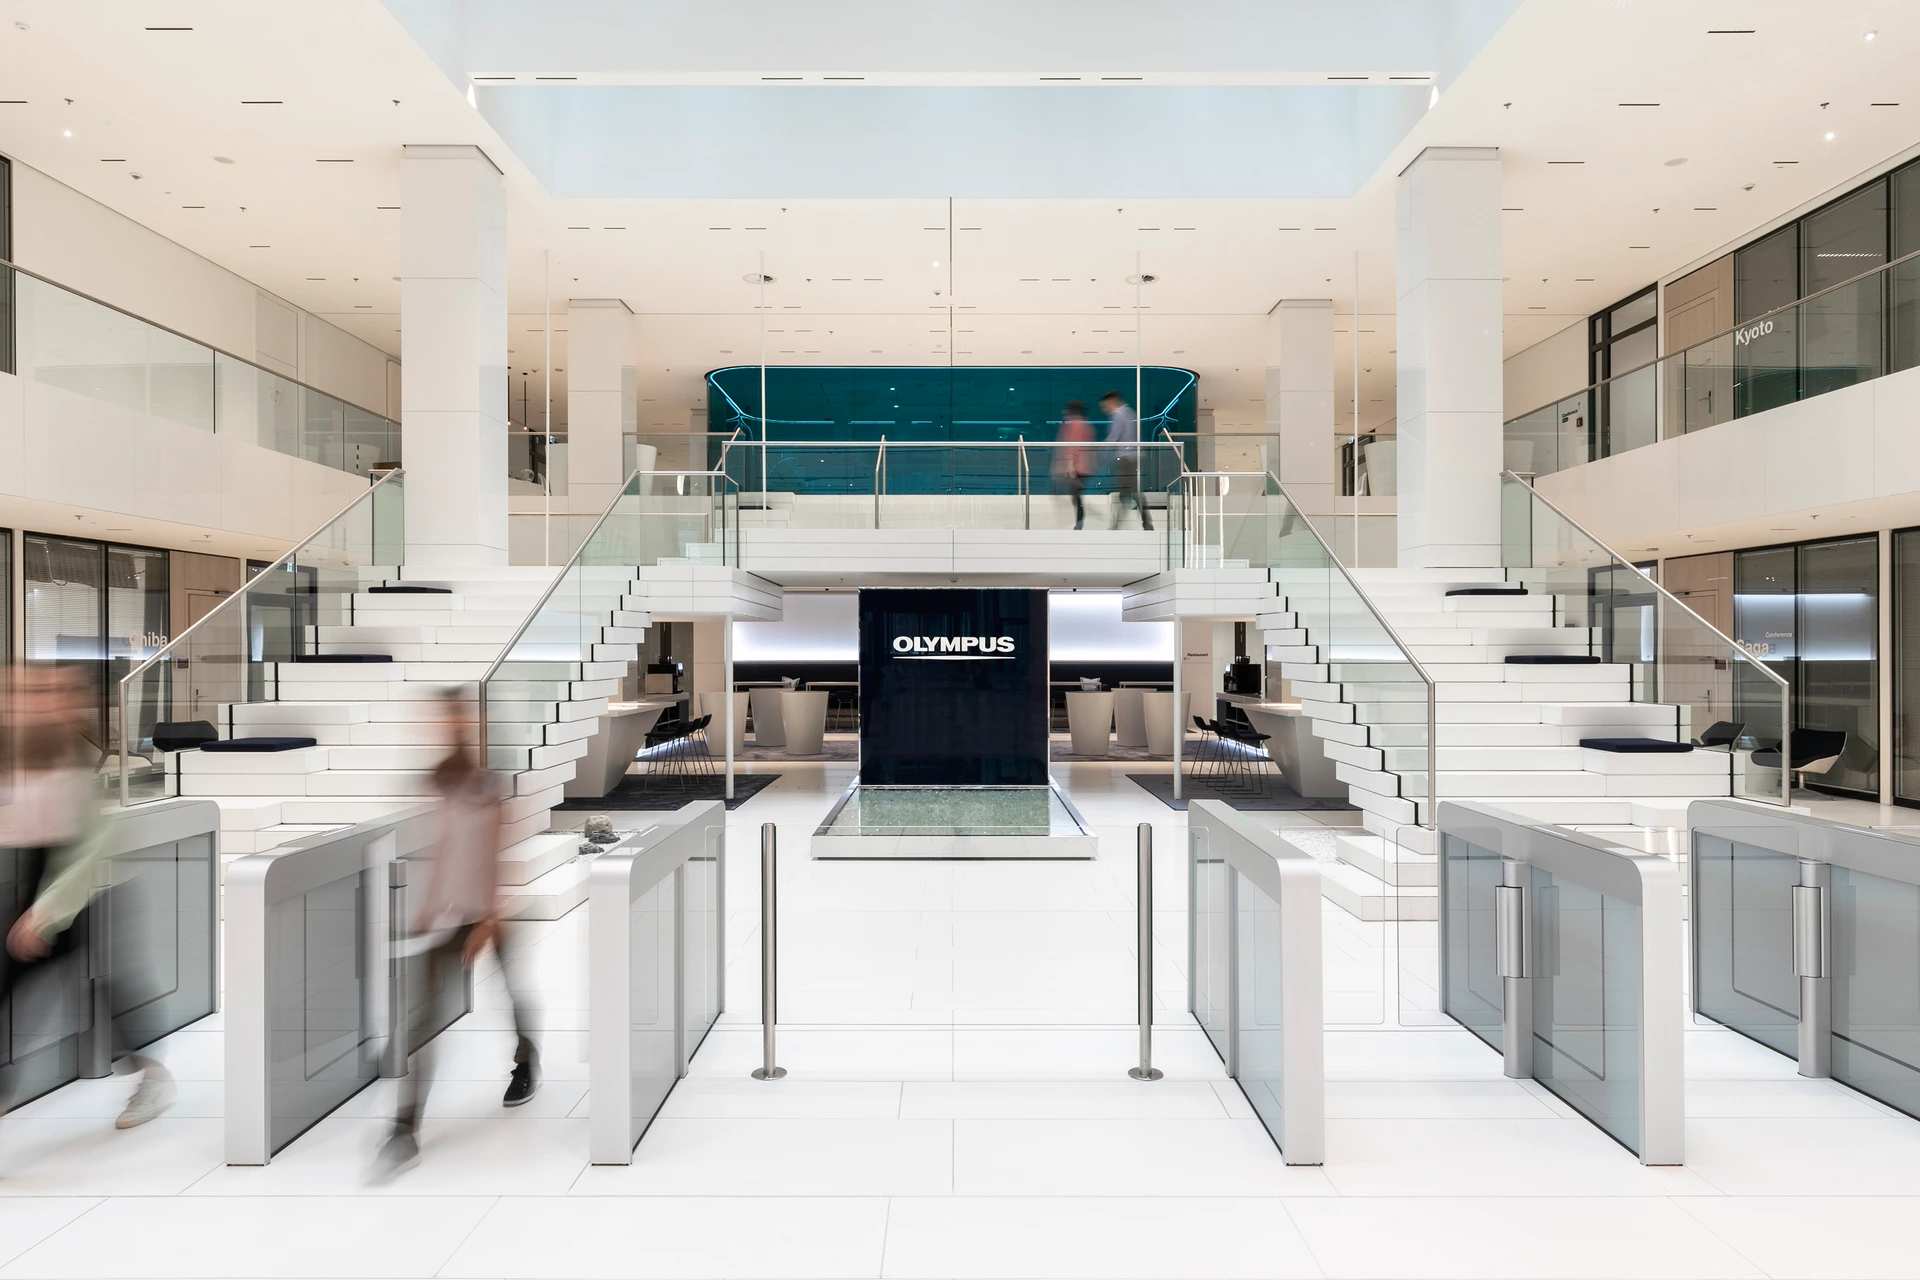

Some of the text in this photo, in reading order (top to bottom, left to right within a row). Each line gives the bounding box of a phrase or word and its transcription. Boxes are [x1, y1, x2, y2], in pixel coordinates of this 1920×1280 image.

[1735, 321, 1774, 346] Kyoto
[129, 631, 168, 648] Chiba
[893, 636, 1015, 652] OLYMPUS
